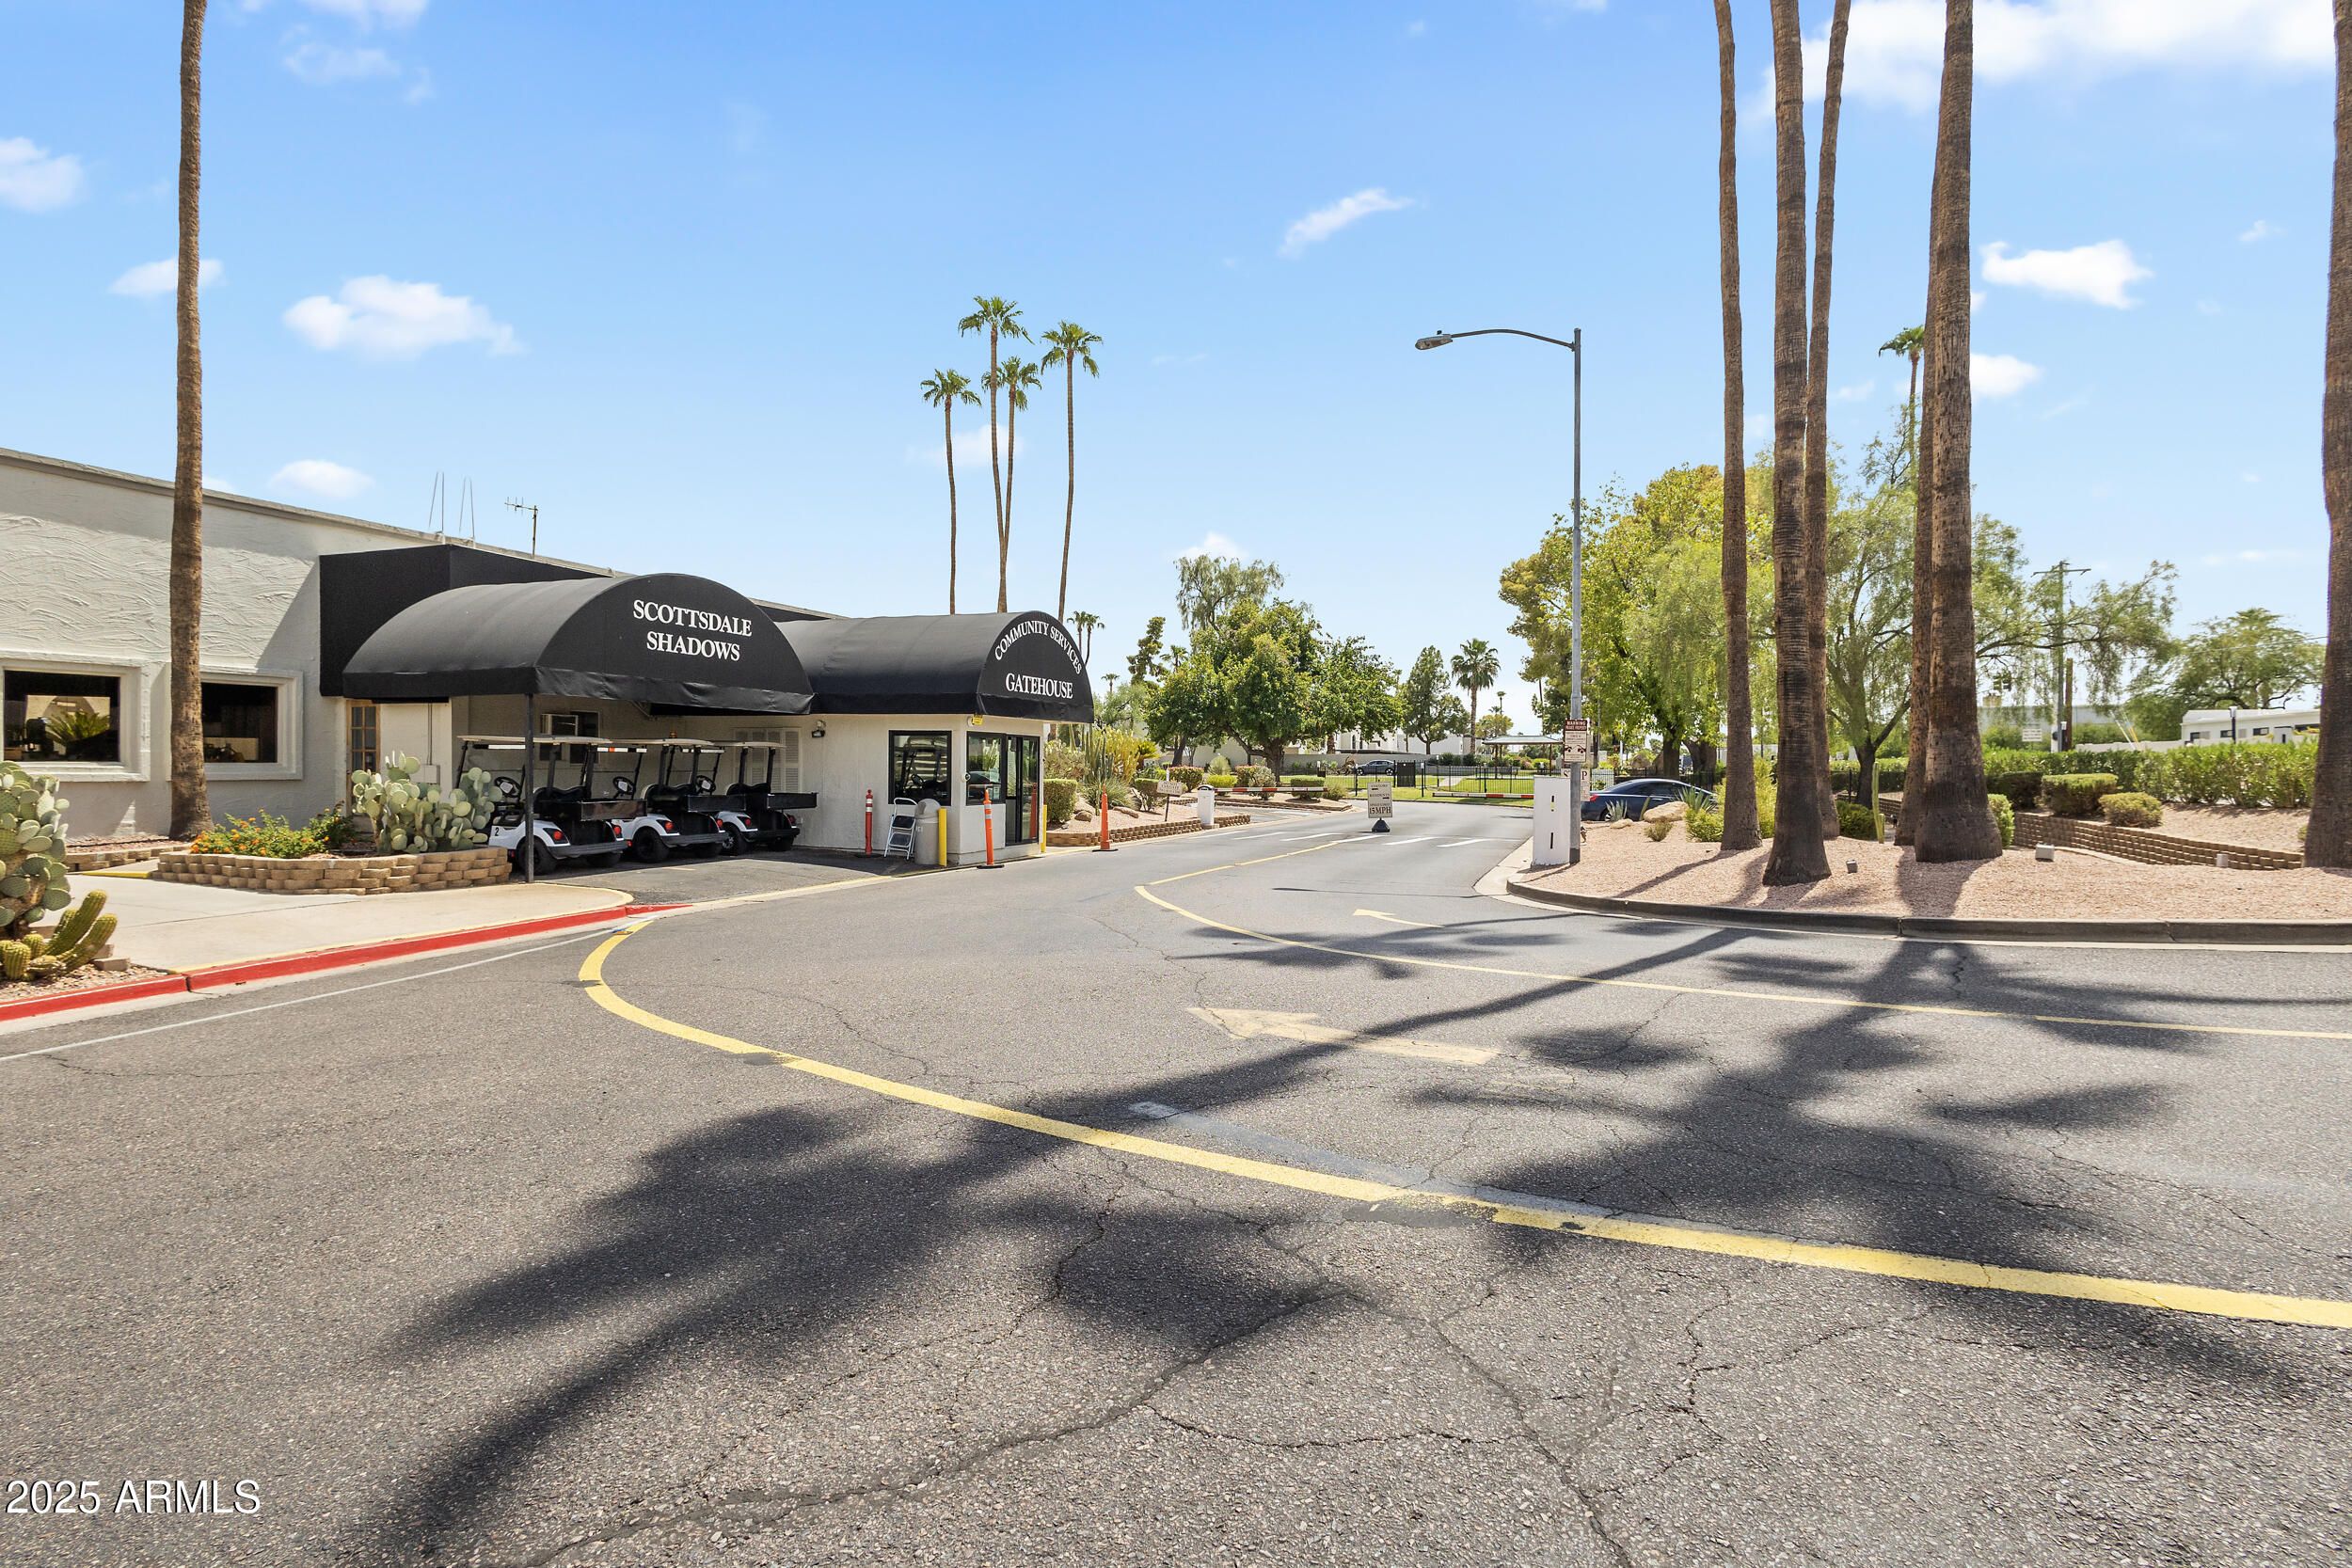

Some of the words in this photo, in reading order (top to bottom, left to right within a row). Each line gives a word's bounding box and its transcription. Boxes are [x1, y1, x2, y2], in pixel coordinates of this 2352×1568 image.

[632, 599, 753, 637] SCOTTSDALE
[646, 630, 740, 661] SHADOWS
[994, 620, 1050, 660] COMMUNITY
[1050, 626, 1082, 674] SERVICES
[1005, 673, 1073, 699] GATEHOUSE
[1563, 770, 1588, 780] SP
[494, 827, 500, 836] 2
